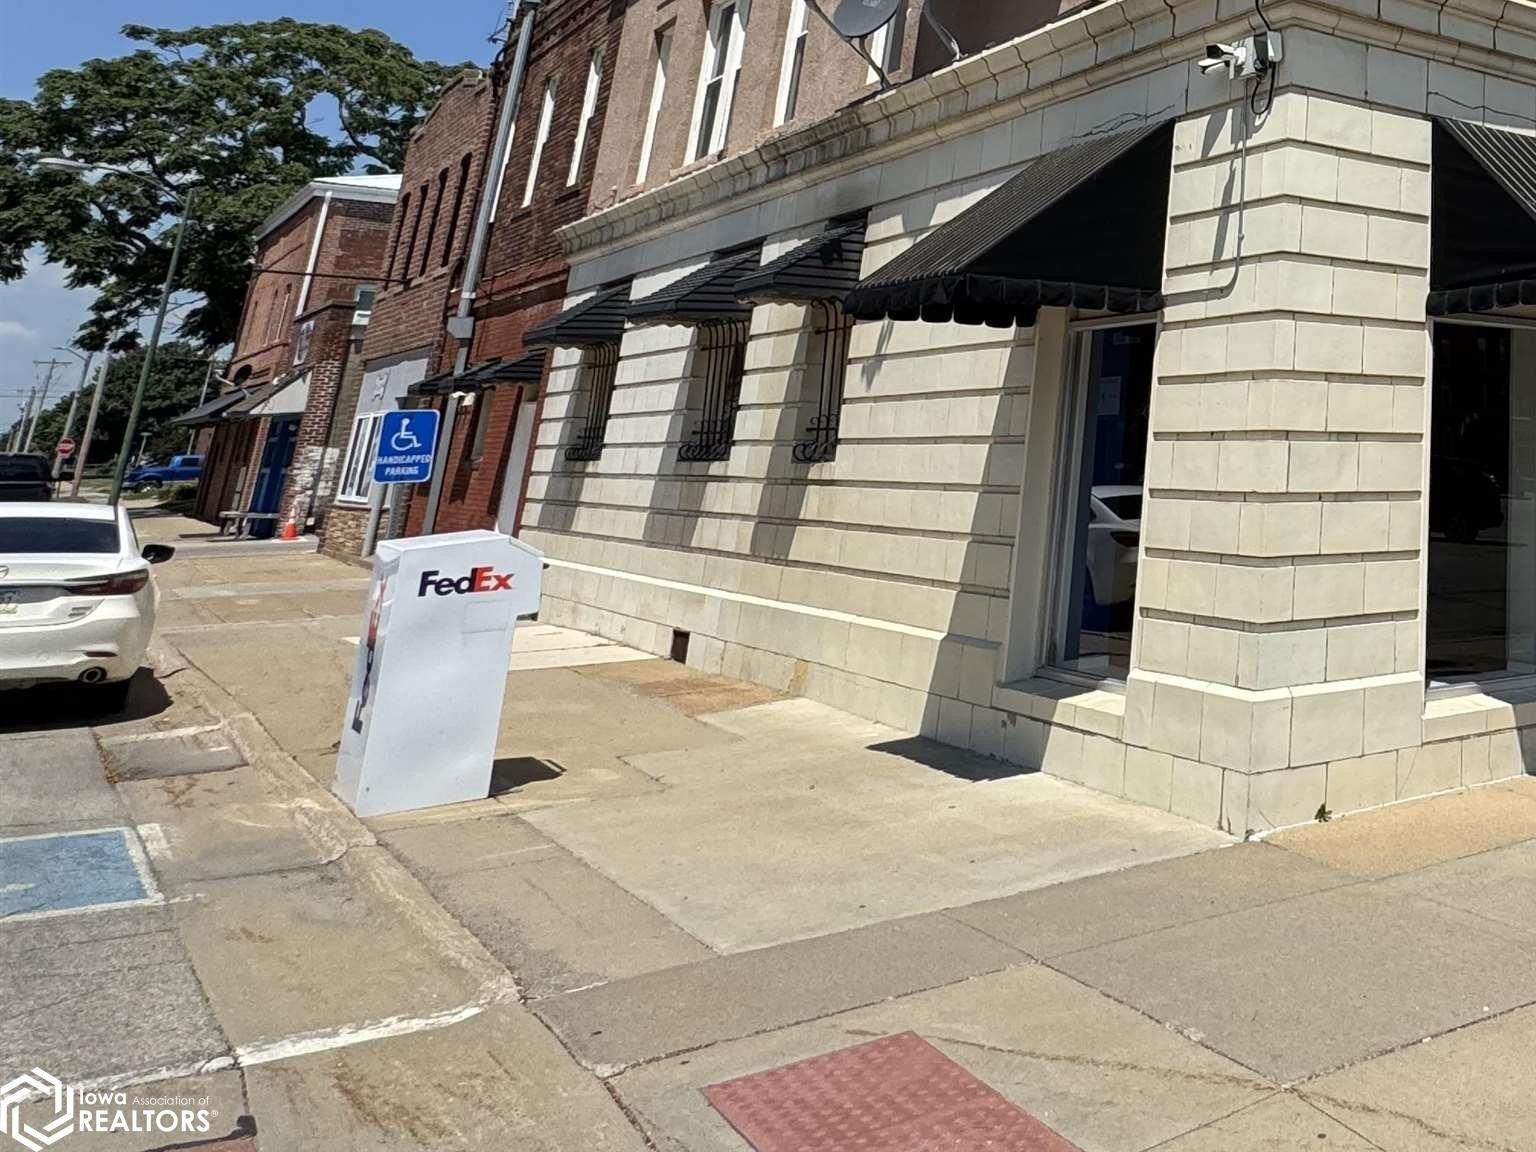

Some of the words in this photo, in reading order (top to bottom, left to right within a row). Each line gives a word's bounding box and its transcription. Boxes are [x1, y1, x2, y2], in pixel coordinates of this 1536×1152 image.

[377, 454, 432, 465] HANDICAPPED
[385, 466, 419, 476] PARKING
[418, 566, 515, 597] FedEx
